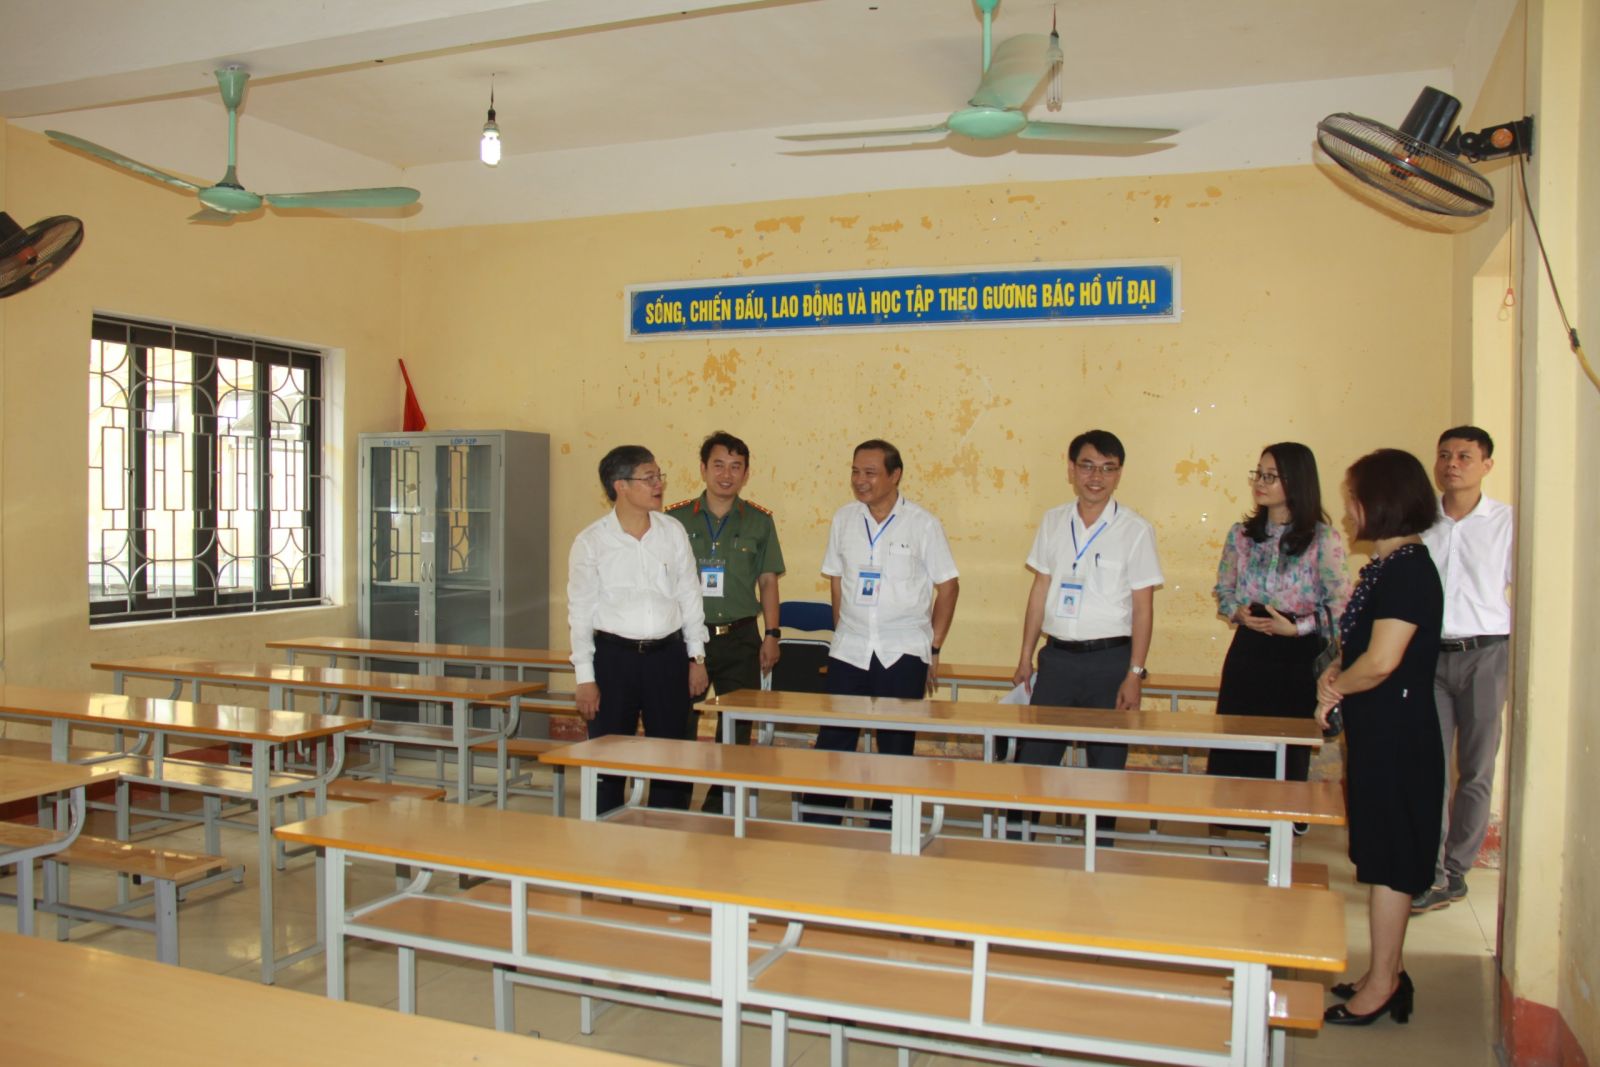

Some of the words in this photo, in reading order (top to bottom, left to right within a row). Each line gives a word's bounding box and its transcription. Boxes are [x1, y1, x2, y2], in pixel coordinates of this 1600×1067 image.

[645, 294, 686, 325] SỐNG,
[690, 291, 731, 321] CHIẾN
[735, 290, 768, 322] ĐẤU,
[772, 295, 799, 318] LAO
[803, 290, 843, 321] ĐỘNG
[847, 287, 867, 315] VÀ
[871, 290, 901, 319] HỌC
[906, 284, 935, 318] TẬP
[939, 287, 978, 312] THEO
[983, 283, 1037, 309] GƯƠNG
[1042, 279, 1075, 307] BÁC
[1080, 273, 1102, 306] HỒ
[1106, 276, 1123, 305] VĨ
[1127, 280, 1156, 309] ĐẠI
